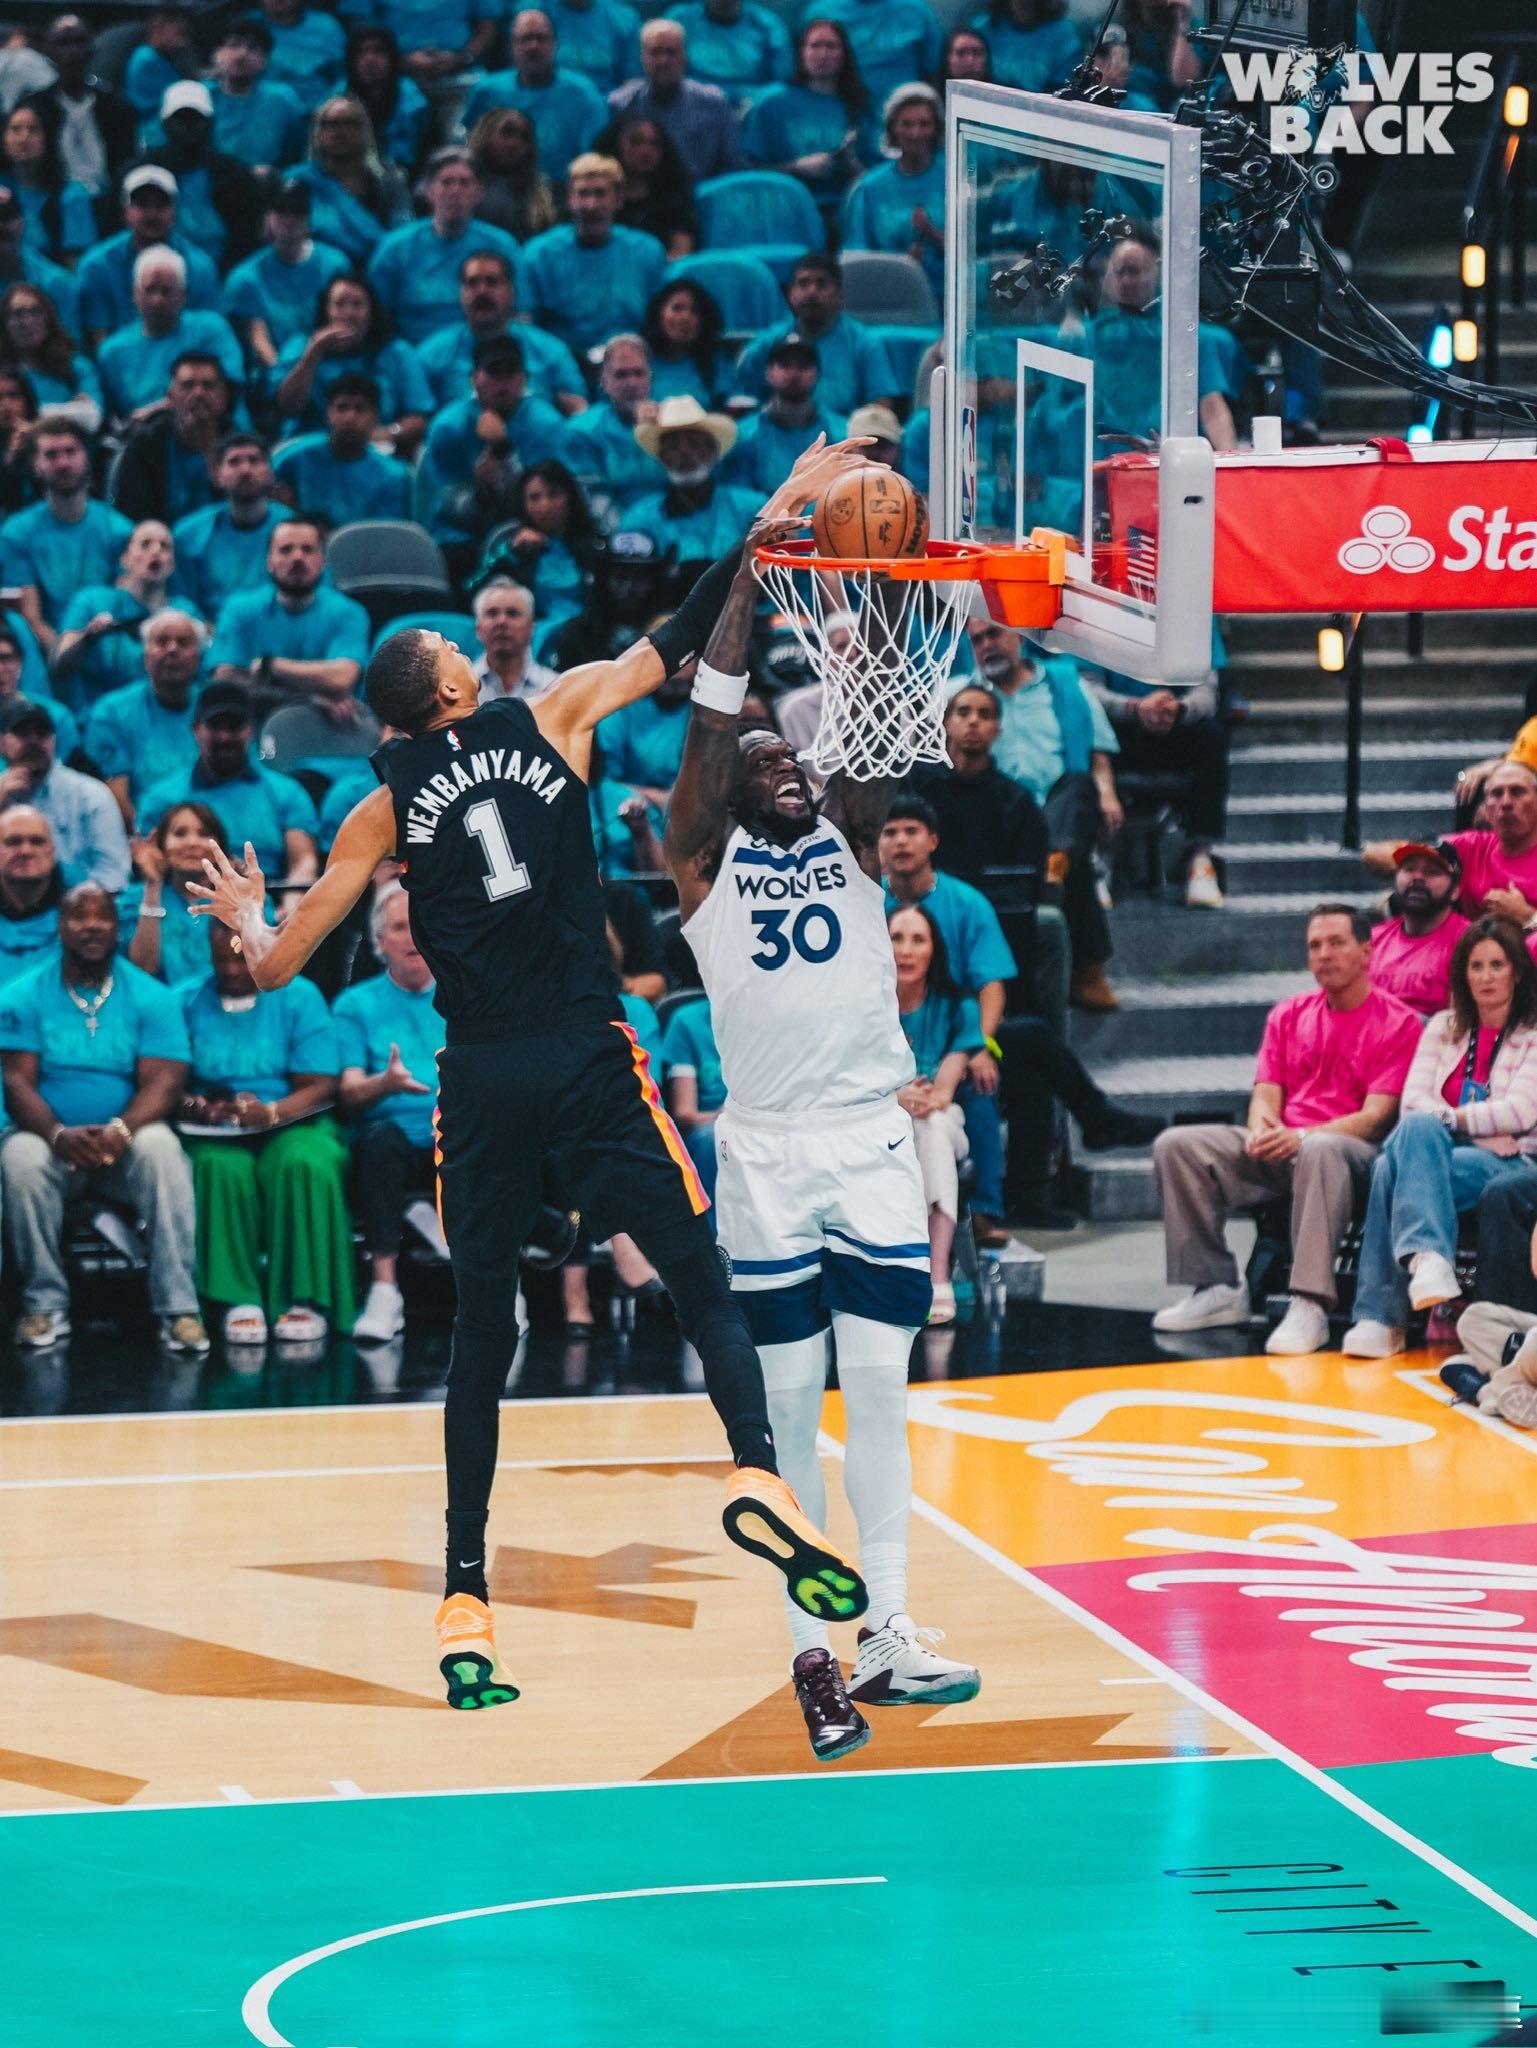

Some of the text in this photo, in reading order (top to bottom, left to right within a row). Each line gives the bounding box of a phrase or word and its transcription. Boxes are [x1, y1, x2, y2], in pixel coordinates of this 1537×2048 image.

[1443, 504, 1537, 571] Sta
[406, 748, 567, 844] WEMBANYAMA
[462, 797, 532, 903] 1
[735, 863, 847, 900] WOLVES
[750, 903, 842, 972] 30
[908, 1387, 1437, 1515] San
[1163, 1862, 1432, 1936] CITY
